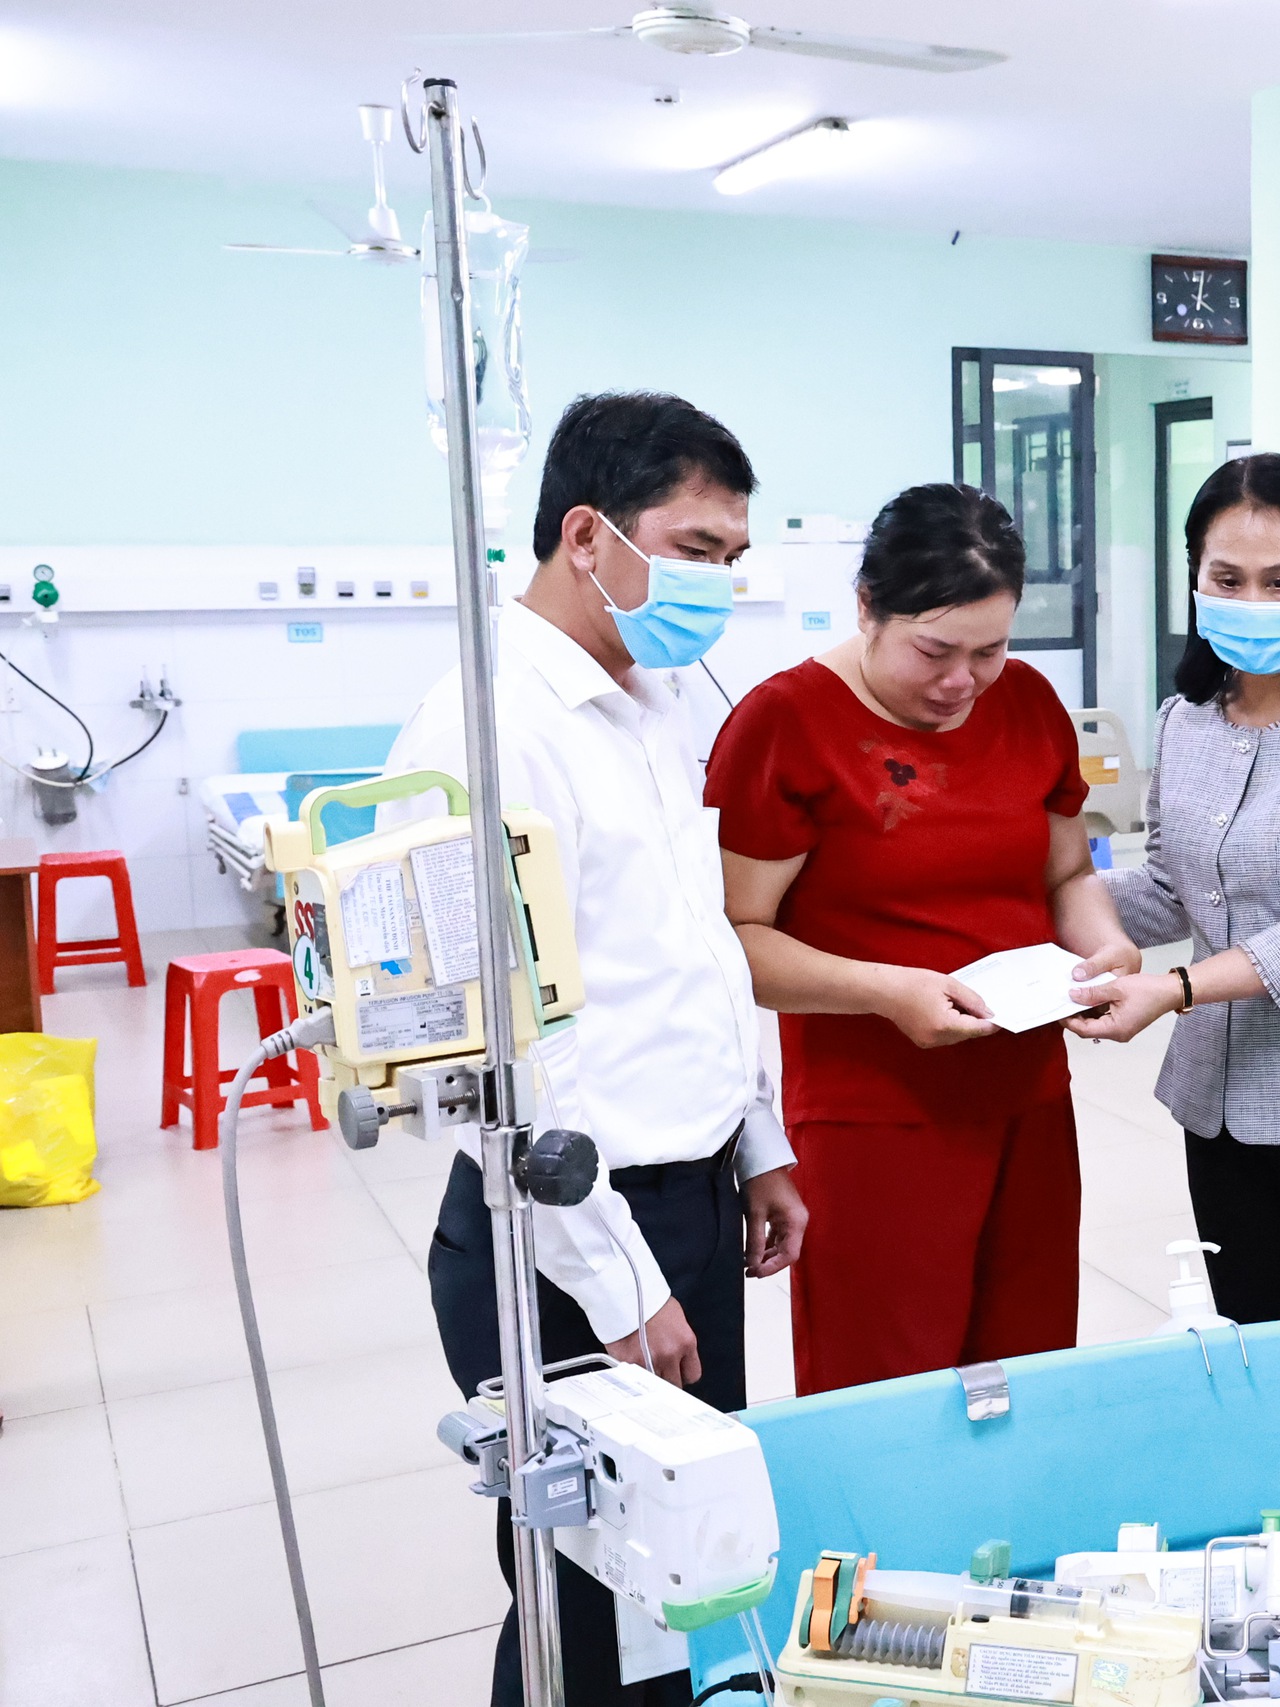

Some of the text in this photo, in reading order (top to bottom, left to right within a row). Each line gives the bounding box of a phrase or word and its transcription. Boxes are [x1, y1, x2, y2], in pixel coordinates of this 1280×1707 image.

[1156, 292, 1168, 305] 9
[1228, 296, 1240, 308] 3
[1192, 317, 1205, 330] 6
[303, 946, 314, 990] 4
